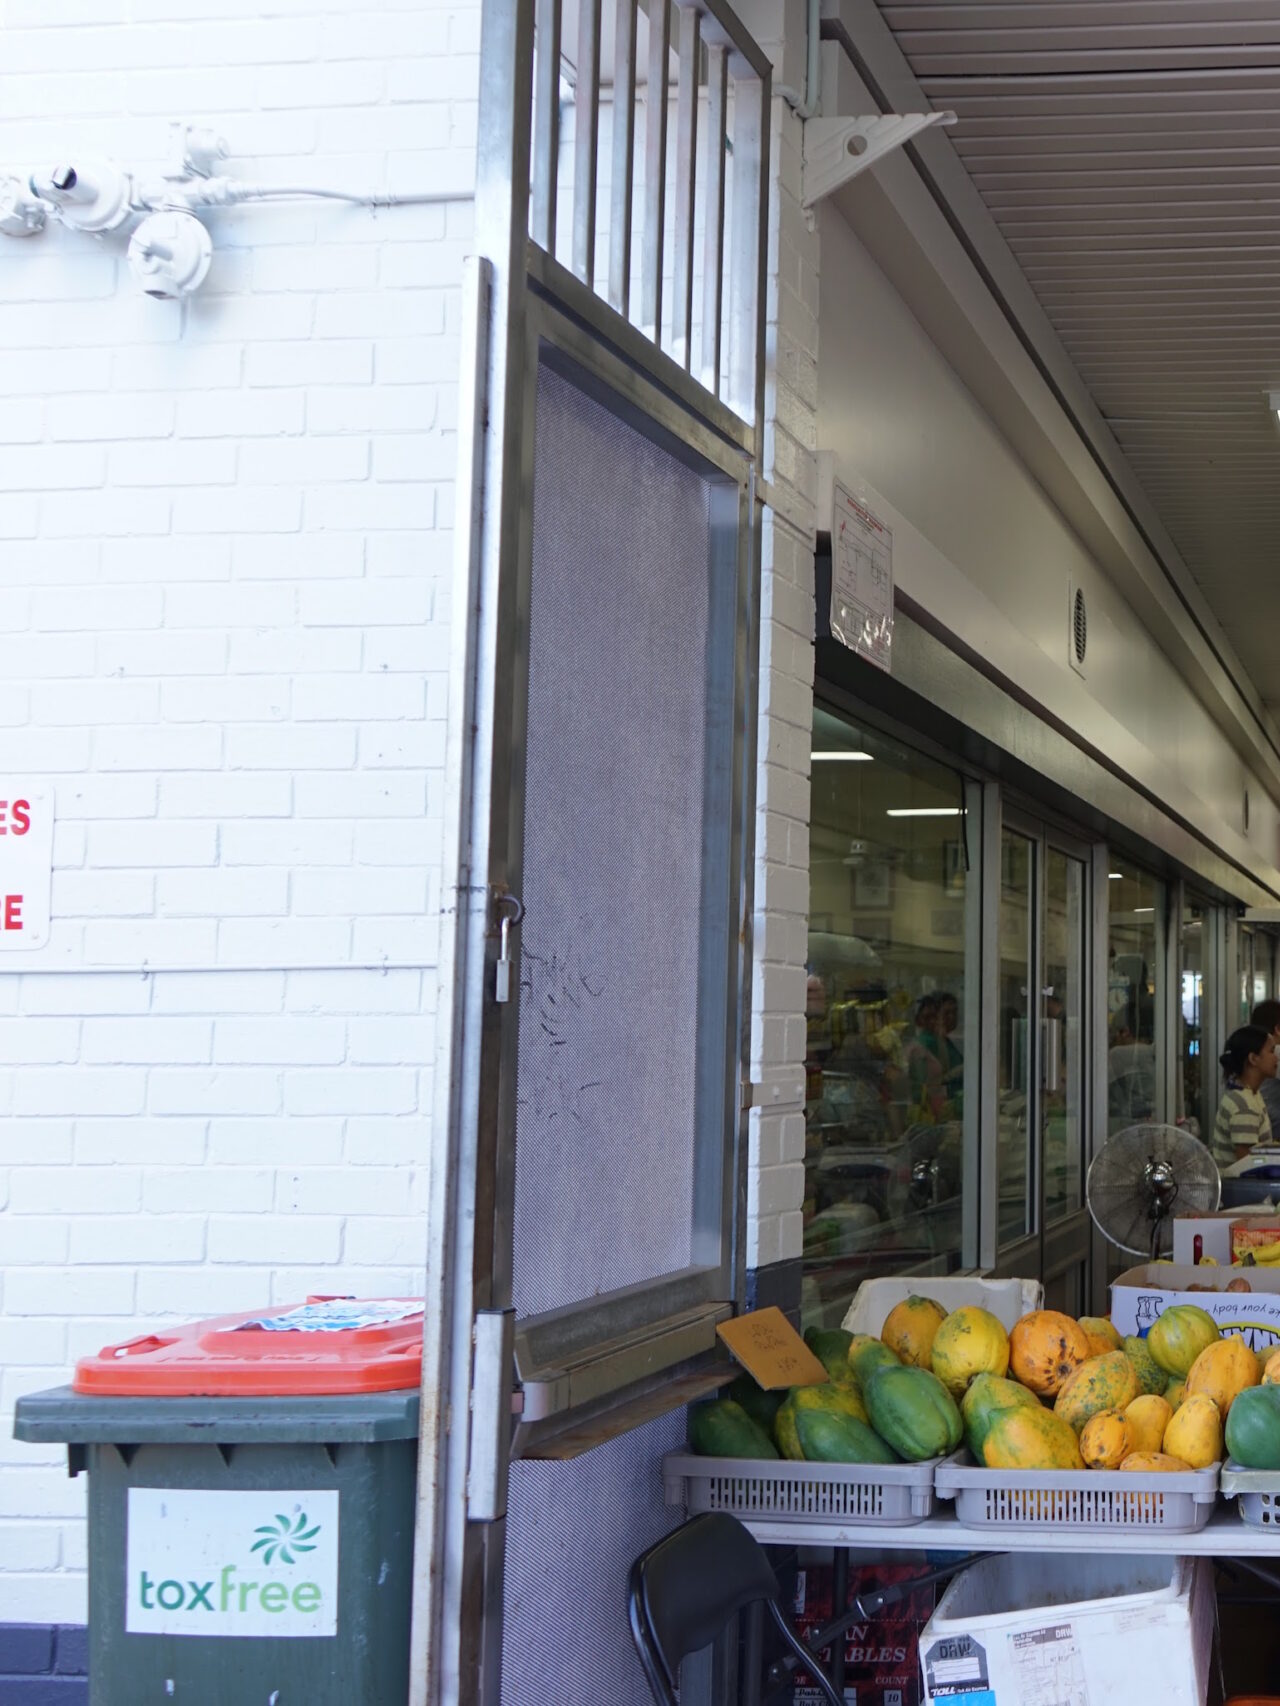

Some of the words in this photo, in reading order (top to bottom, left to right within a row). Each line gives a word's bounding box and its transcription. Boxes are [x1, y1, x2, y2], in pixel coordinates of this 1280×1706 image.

[1213, 1303, 1238, 1315] body
[1241, 1304, 1266, 1313] your
[140, 1564, 322, 1613] toxfree
[875, 1676, 909, 1685] COUNT
[930, 1686, 956, 1696] TOLL
[888, 1693, 899, 1703] 10
